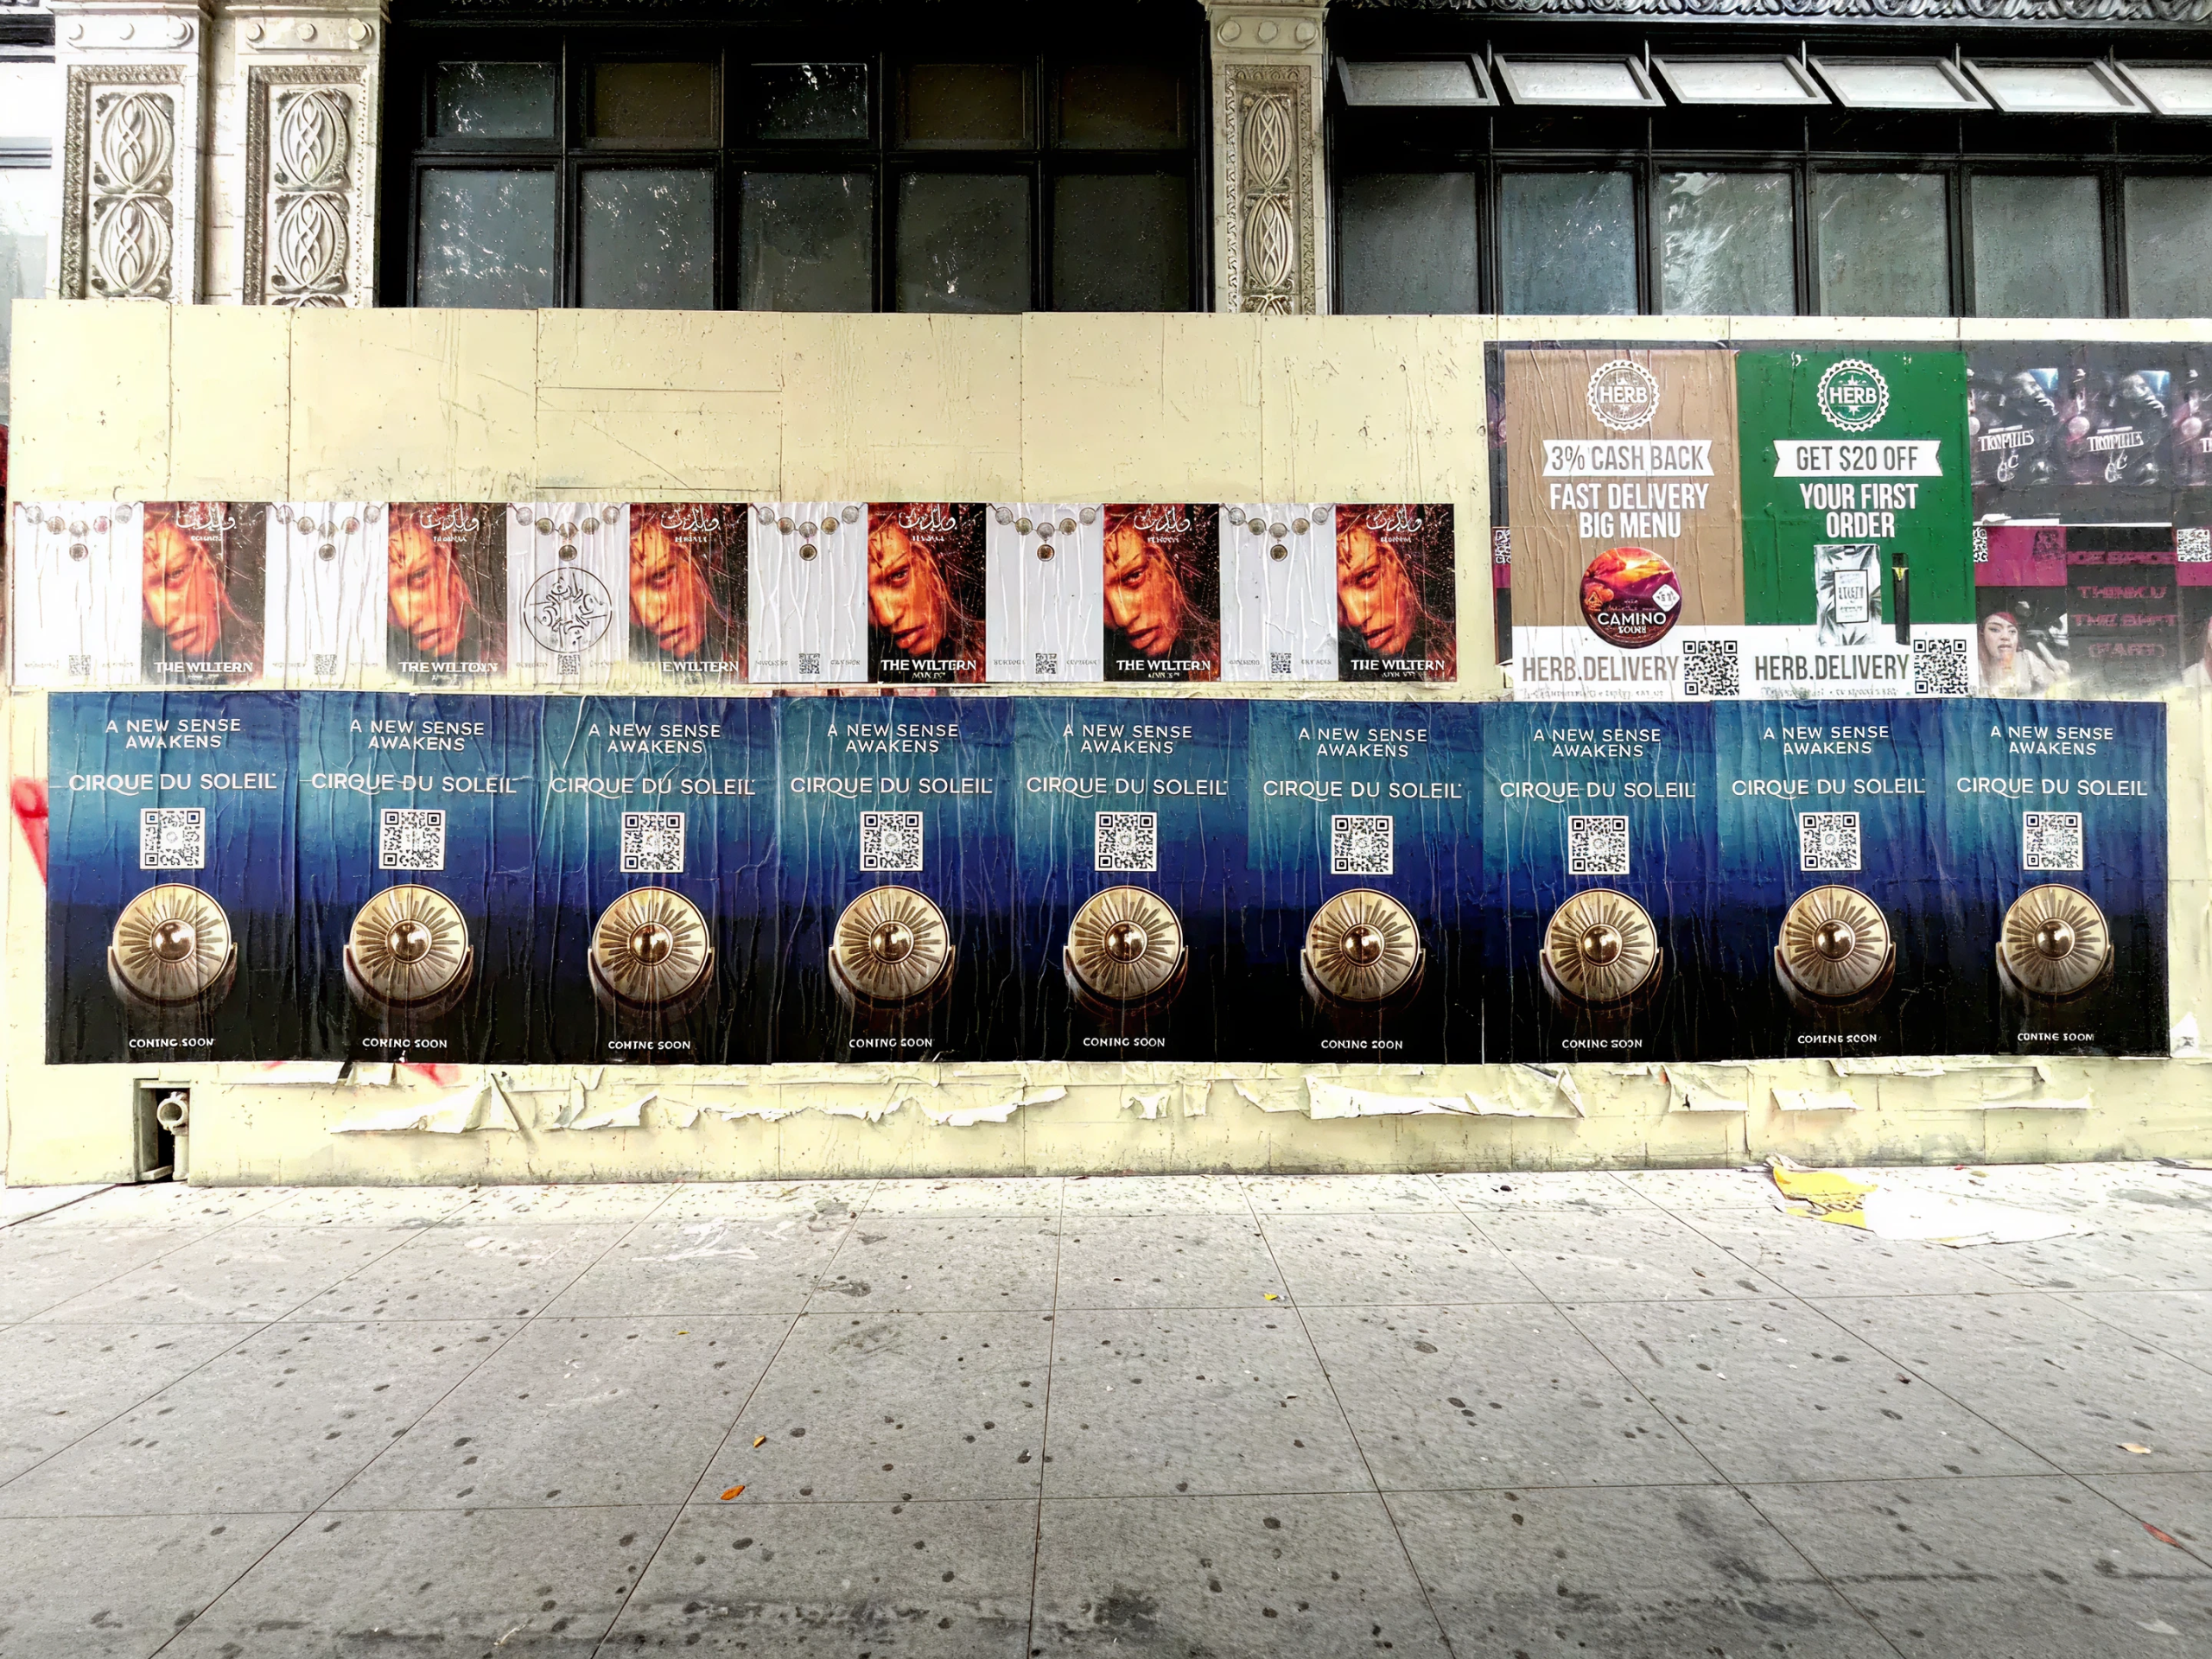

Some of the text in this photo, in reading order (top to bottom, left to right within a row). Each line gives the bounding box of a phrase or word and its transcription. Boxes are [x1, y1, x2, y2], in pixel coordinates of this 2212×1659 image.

[1599, 385, 1649, 404] HERB
[1829, 386, 1877, 404] HERB
[1551, 446, 1705, 471] 3% CASH BACK
[1796, 444, 1920, 472] GET $20 OFF
[1549, 483, 1709, 510] FAST DELIVERY
[1799, 484, 1919, 510] YOUR FIRST
[1580, 512, 1682, 538] BIG MENU
[1826, 513, 1895, 538] ORDER
[1598, 612, 1666, 625] CAMINO
[154, 662, 253, 672] THE WILTERN
[673, 661, 738, 671] WILTERN
[880, 660, 909, 671] THE
[1116, 660, 1144, 671] THE
[1382, 660, 1445, 670] WILTERN
[1522, 656, 1679, 681] HERB.DELIVERY
[1755, 654, 1910, 680] HERB.DELIVERY
[105, 718, 242, 734] A NEW SENSE
[350, 719, 486, 736] A NEW SENSE
[588, 724, 721, 738] A NEW SENSE
[828, 723, 959, 737] A NEW SENSE
[1063, 724, 1192, 739] A NEW SENSE
[1764, 726, 1890, 741] A NEW SENSE
[1991, 725, 2113, 741] A NEW SENSE
[125, 735, 223, 749] AWAKENS
[1299, 728, 1427, 742] A NEW SENSE
[1534, 728, 1662, 742] A NEW SENSE
[368, 736, 466, 751] AWAKENS
[607, 740, 703, 754] AWAKENS
[845, 739, 940, 753] AWAKENS
[1080, 740, 1174, 753] AWAKENS
[1317, 743, 1408, 757] AWAKENS
[1552, 744, 1643, 758] AWAKENS
[1784, 741, 1872, 755] AWAKENS
[2009, 741, 2097, 756] AWAKENS
[69, 772, 276, 796] CIRQUE DU SOLEIL
[312, 773, 516, 795] CIRQUE DU SOLEIL
[551, 777, 753, 799] CIRQUE DU SOLEIL
[791, 777, 992, 798] CIRQUE DU SOLEIL
[1027, 777, 1228, 799] CIRQUE DU SOLEIL
[1263, 781, 1463, 802] CIRQUE DU SOLEIL
[1732, 778, 1926, 800] CIRQUE DU SOLEIL
[1957, 777, 2148, 799] CIRQUE DU SOLEIL
[1500, 782, 1697, 803] CIRQUE DU SOLEIL
[182, 1038, 214, 1047] SOON
[414, 1039, 448, 1048] SOON
[658, 1041, 690, 1050] SOON
[901, 1039, 932, 1047] SOON
[1134, 1038, 1165, 1047] SOON
